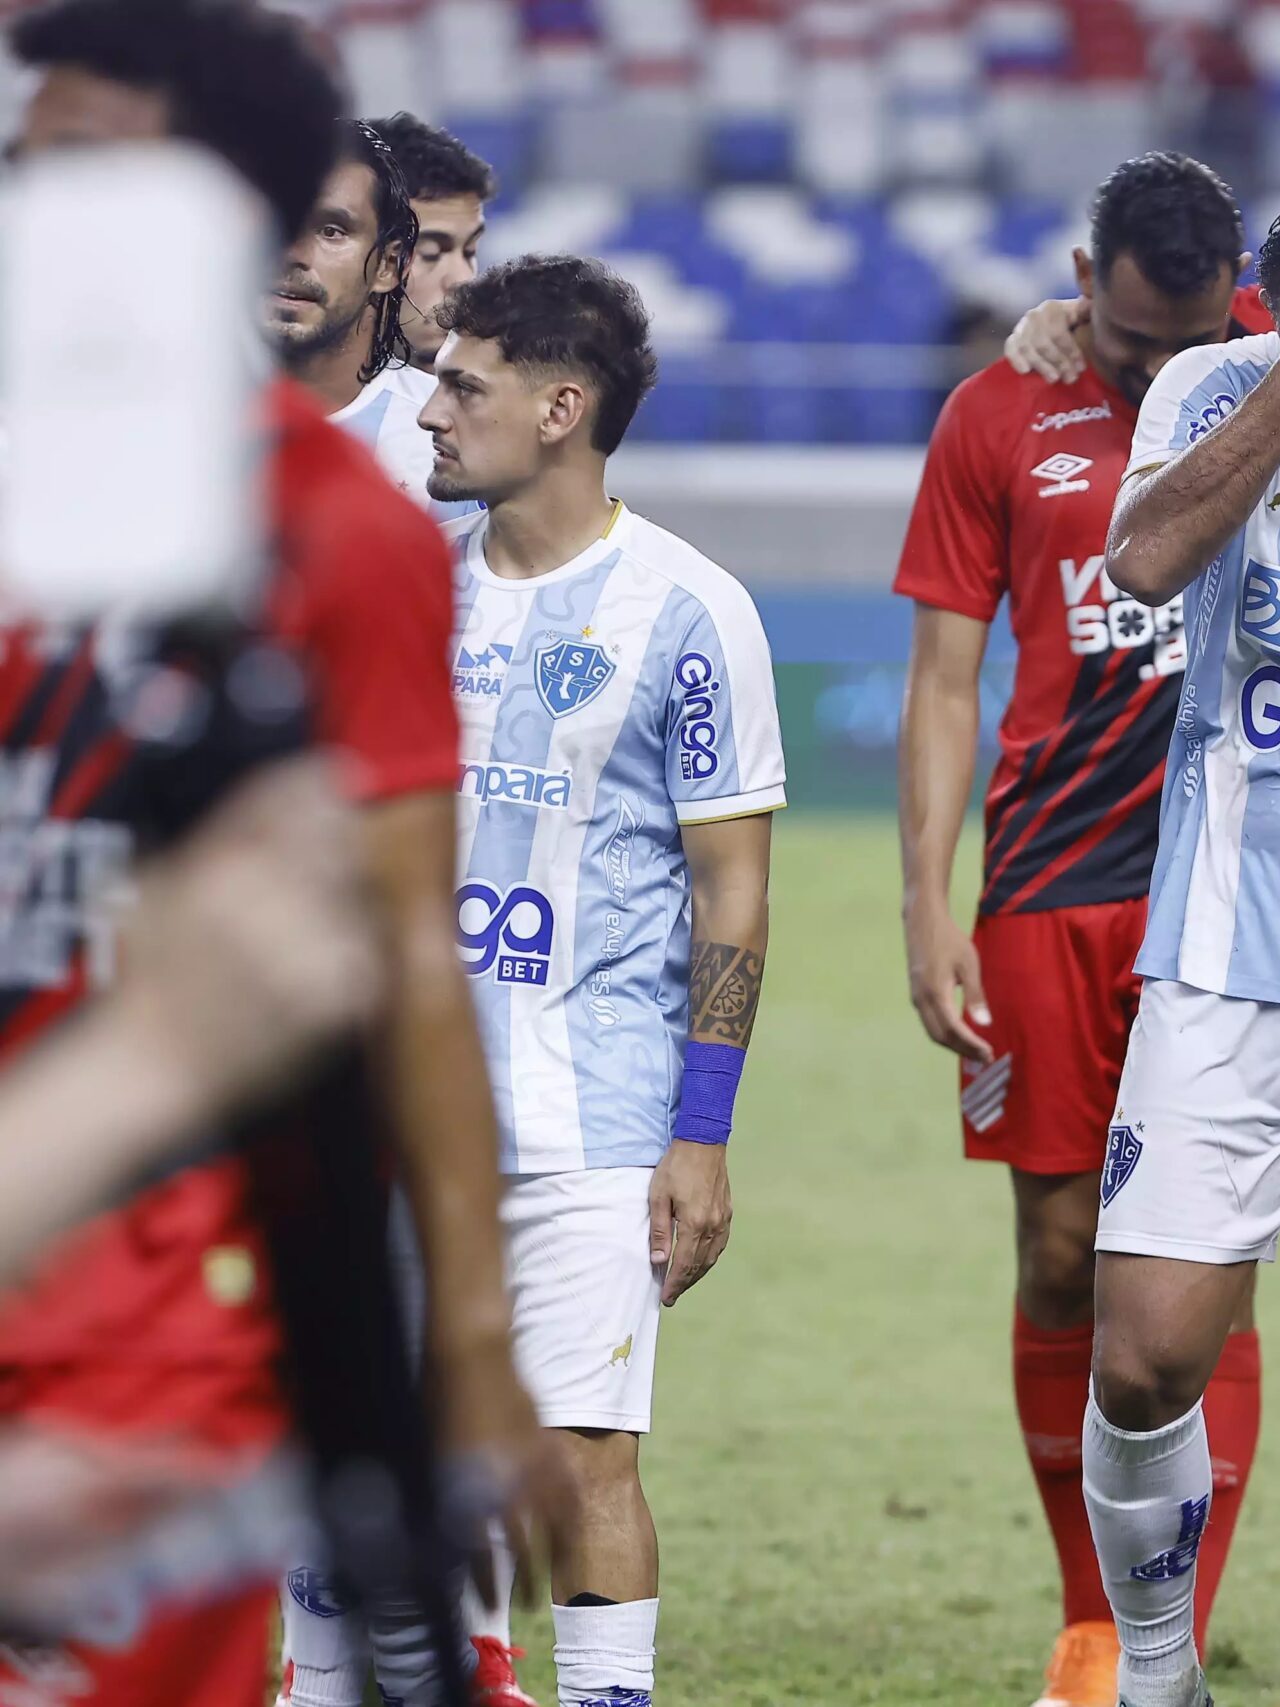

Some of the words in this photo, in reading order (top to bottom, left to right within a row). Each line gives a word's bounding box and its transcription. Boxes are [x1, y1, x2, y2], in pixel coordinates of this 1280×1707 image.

[675, 652, 720, 780] Ginga
[456, 768, 571, 808] npará
[501, 959, 542, 980] BET
